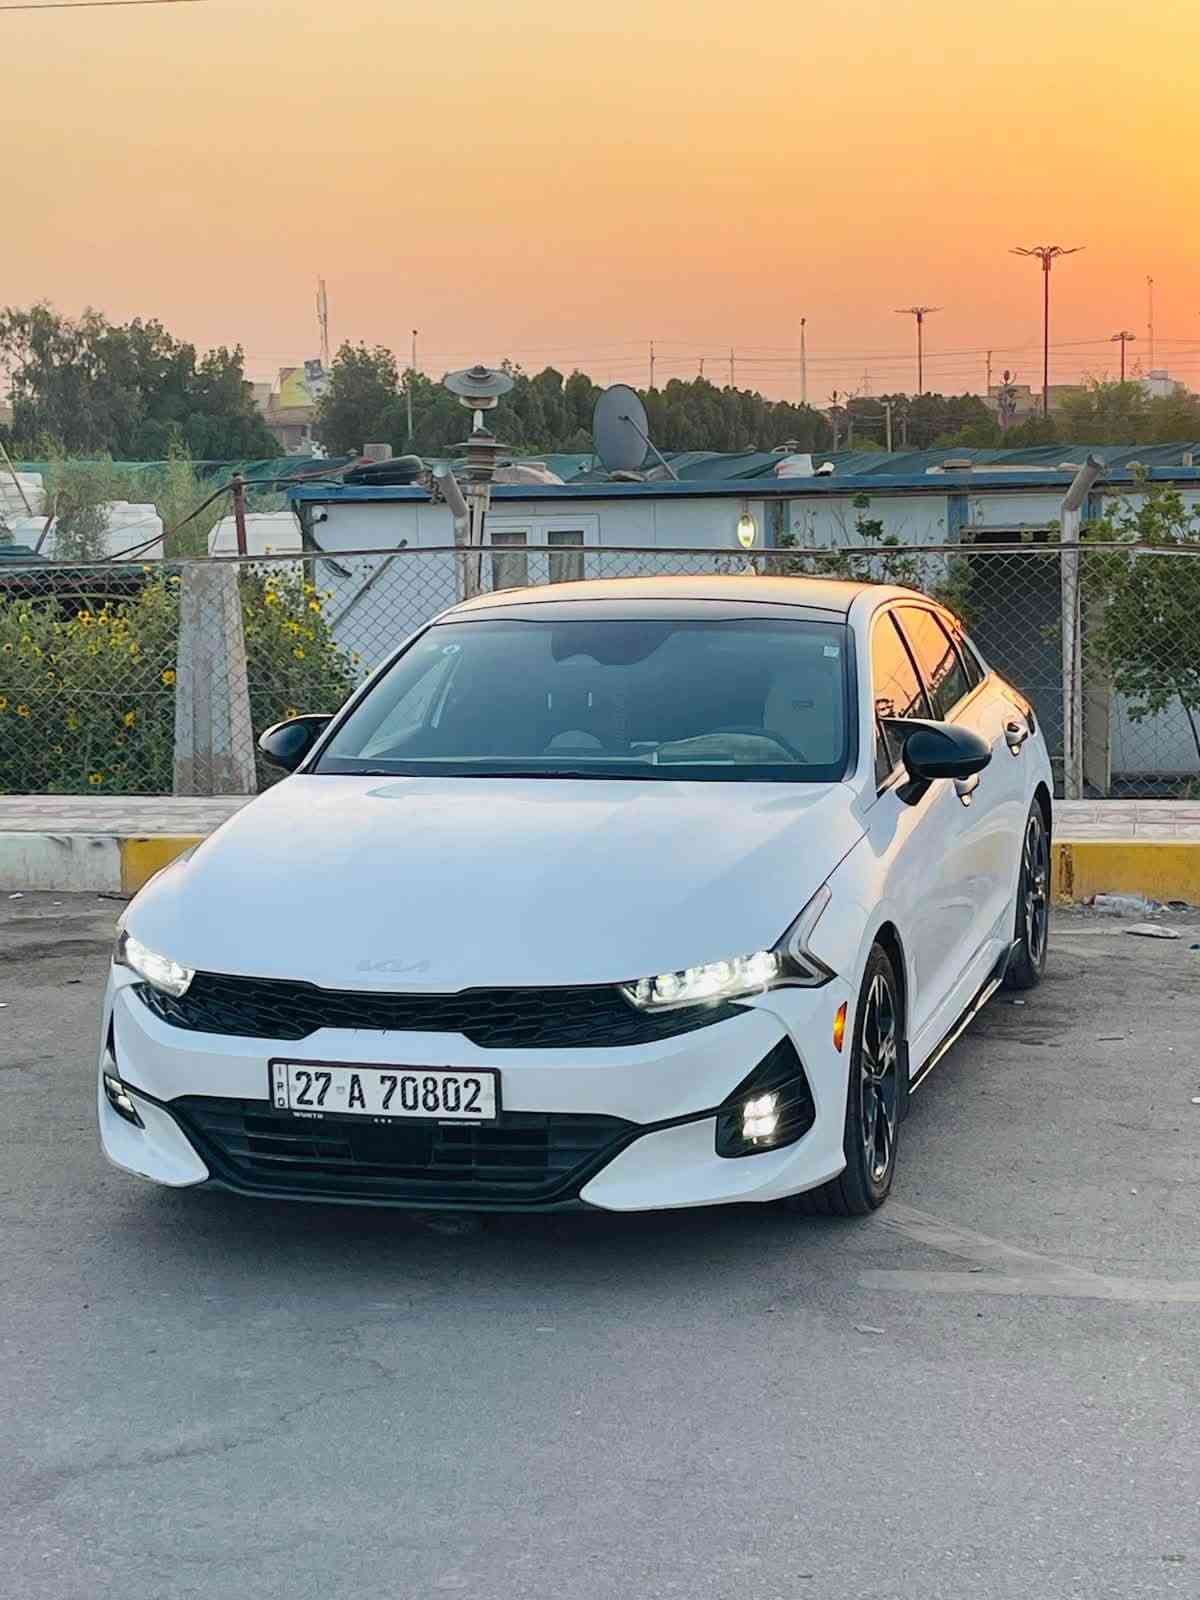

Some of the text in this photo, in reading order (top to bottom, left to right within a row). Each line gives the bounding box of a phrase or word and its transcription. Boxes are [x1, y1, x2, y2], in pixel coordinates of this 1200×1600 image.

[295, 1071, 482, 1113] 27 A 70802
